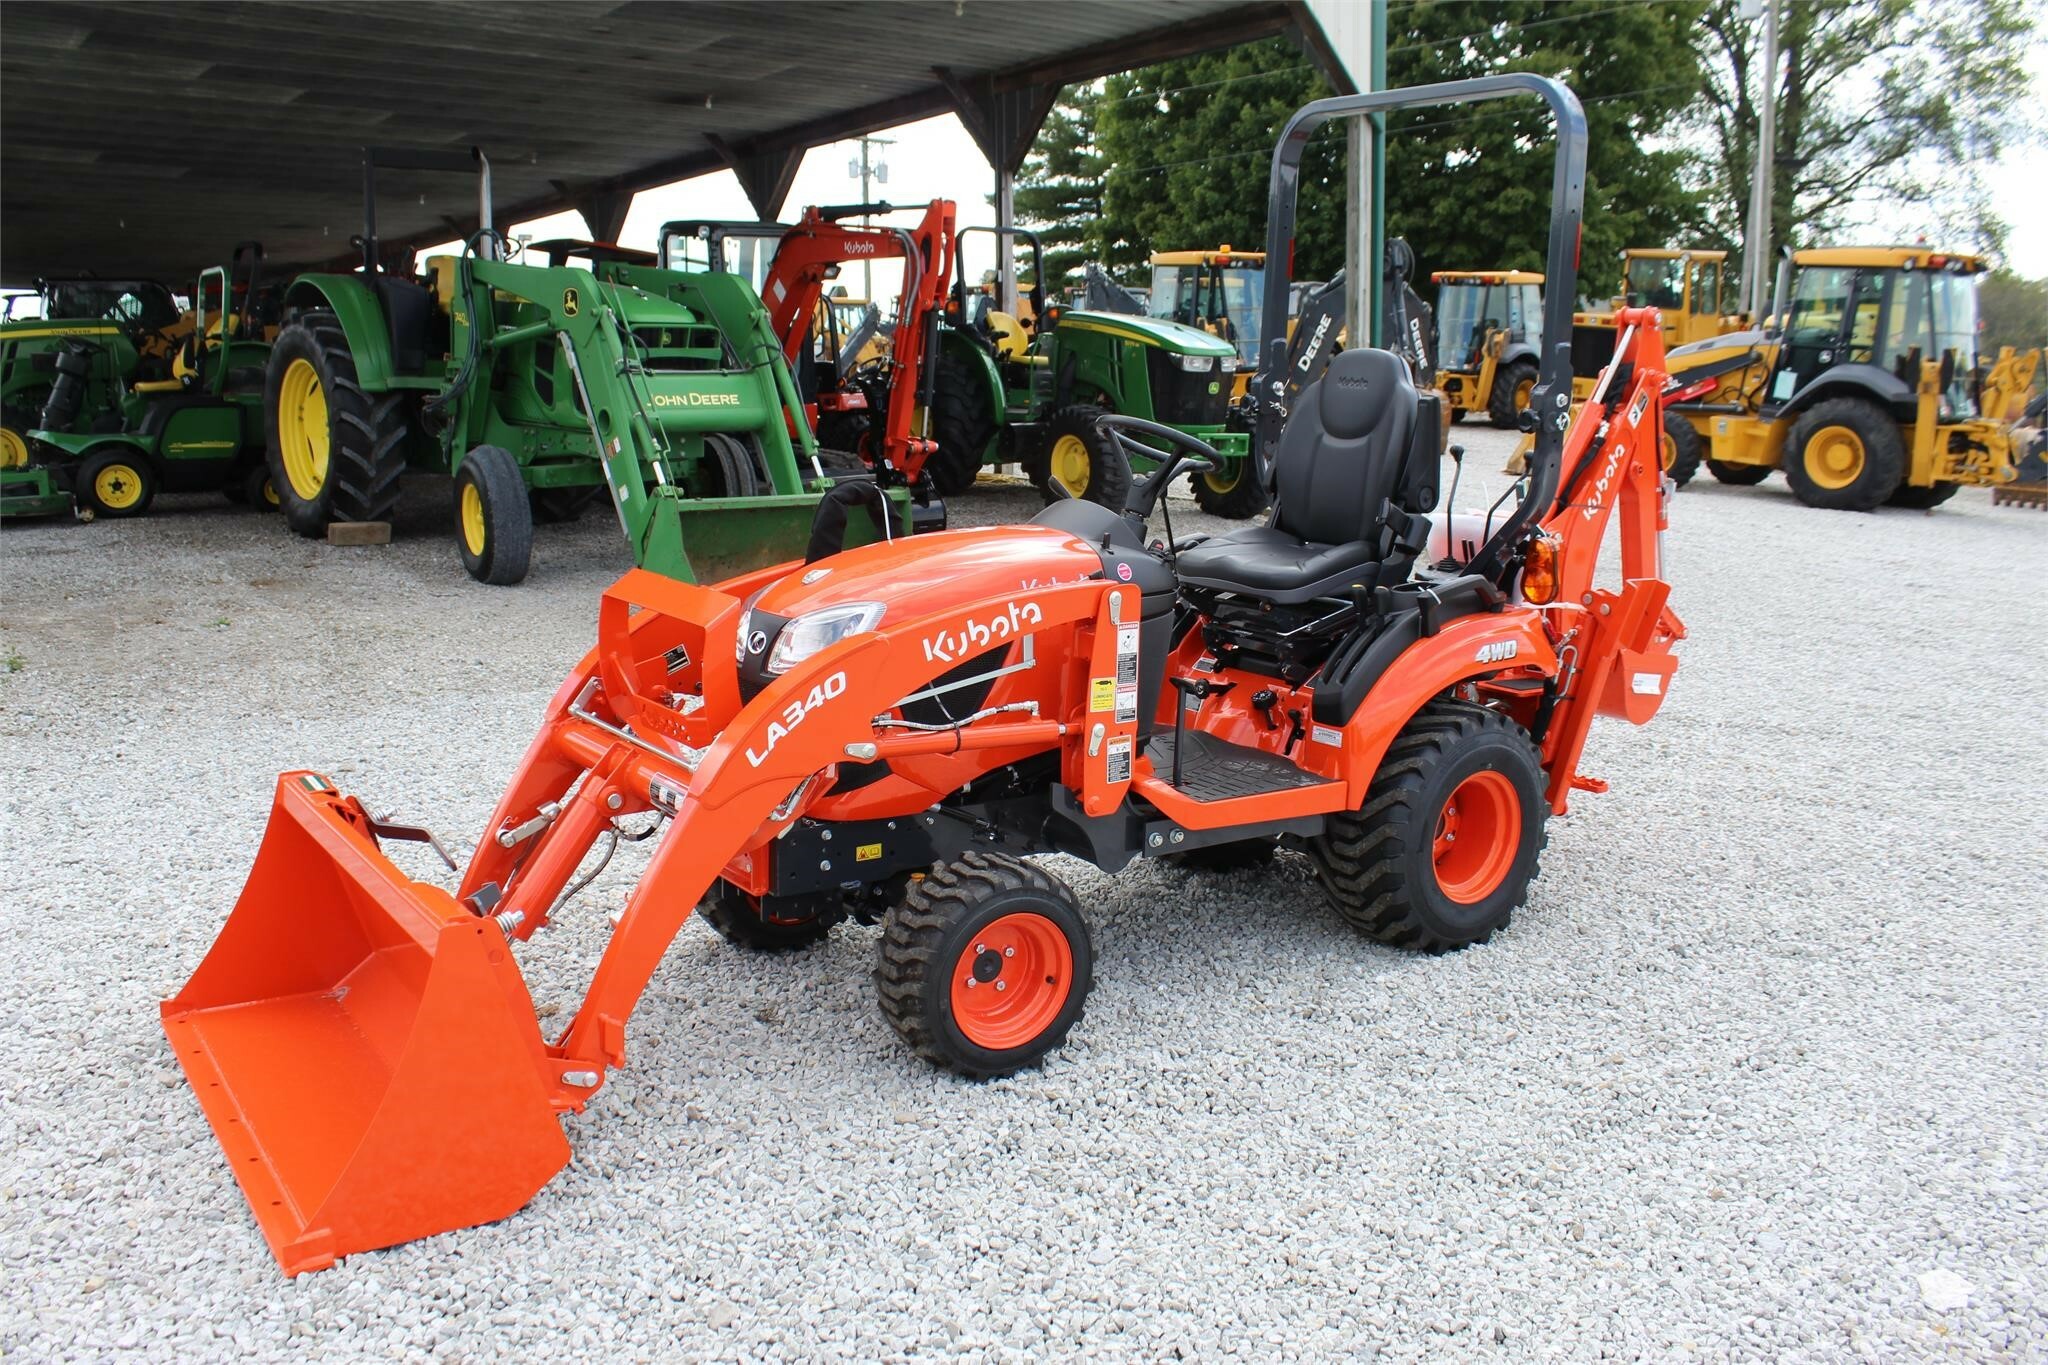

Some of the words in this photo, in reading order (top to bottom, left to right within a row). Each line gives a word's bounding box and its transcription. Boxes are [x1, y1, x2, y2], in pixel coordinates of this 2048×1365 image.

[844, 240, 875, 254] Kubota
[1297, 313, 1332, 372] DEERE
[689, 392, 740, 406] DEERE
[1582, 444, 1625, 521] Kubota
[922, 601, 1043, 663] Kubota
[1475, 640, 1517, 664] 4WD
[745, 671, 846, 768] LA340
